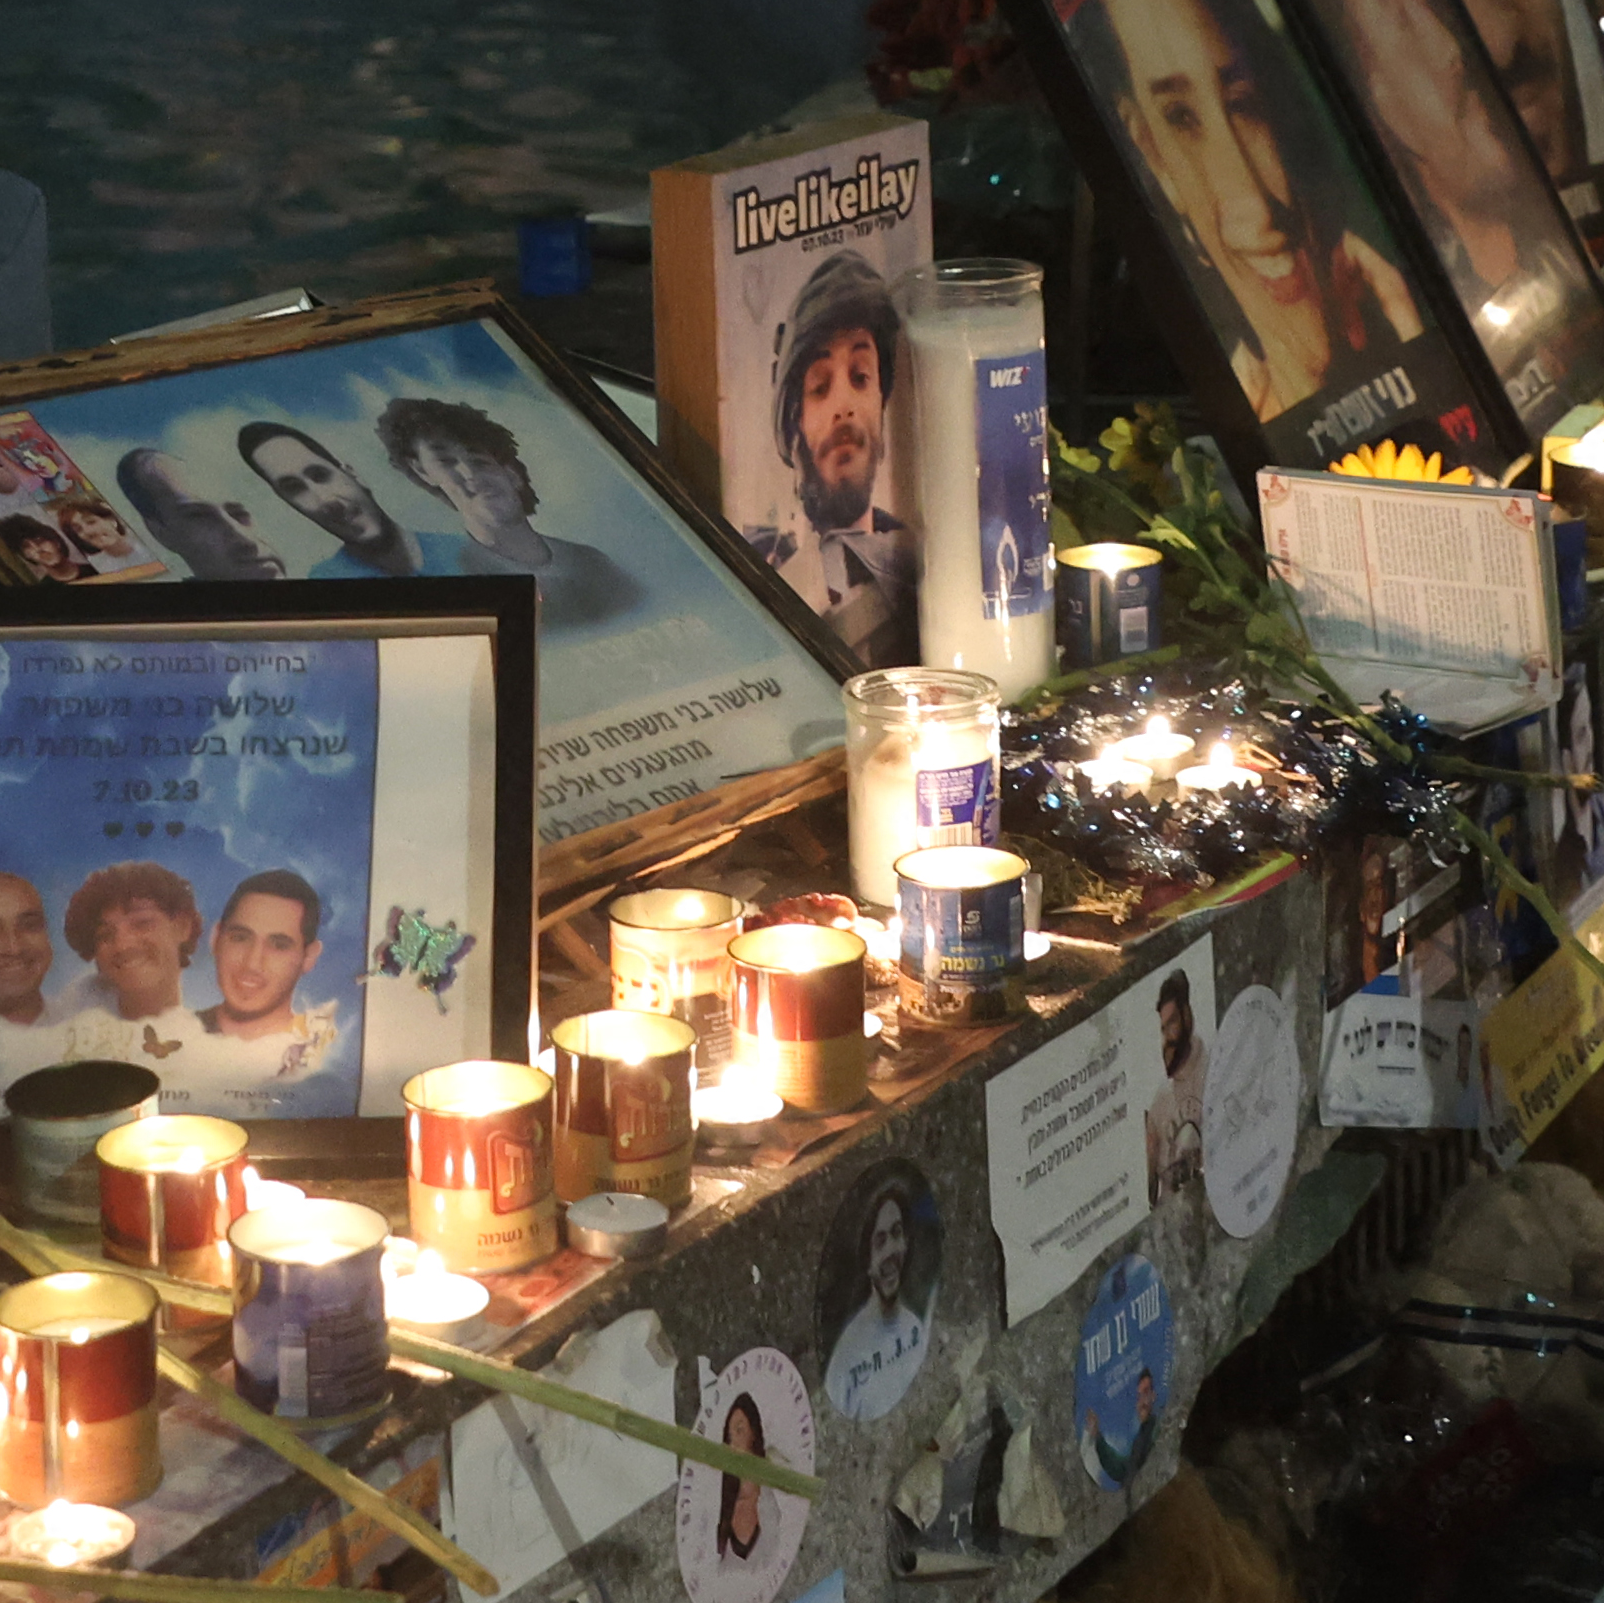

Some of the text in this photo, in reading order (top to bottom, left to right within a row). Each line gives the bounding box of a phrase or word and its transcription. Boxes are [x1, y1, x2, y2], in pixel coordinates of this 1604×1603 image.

[734, 154, 919, 254] livelikeilay
[196, 692, 295, 718] שלושה
[673, 699, 715, 724] בני
[708, 676, 783, 716] שלושה
[140, 735, 229, 758] בשבת
[240, 734, 349, 758] שנרצחו
[588, 710, 680, 751] משפחה
[598, 738, 713, 787] מתגעגעים
